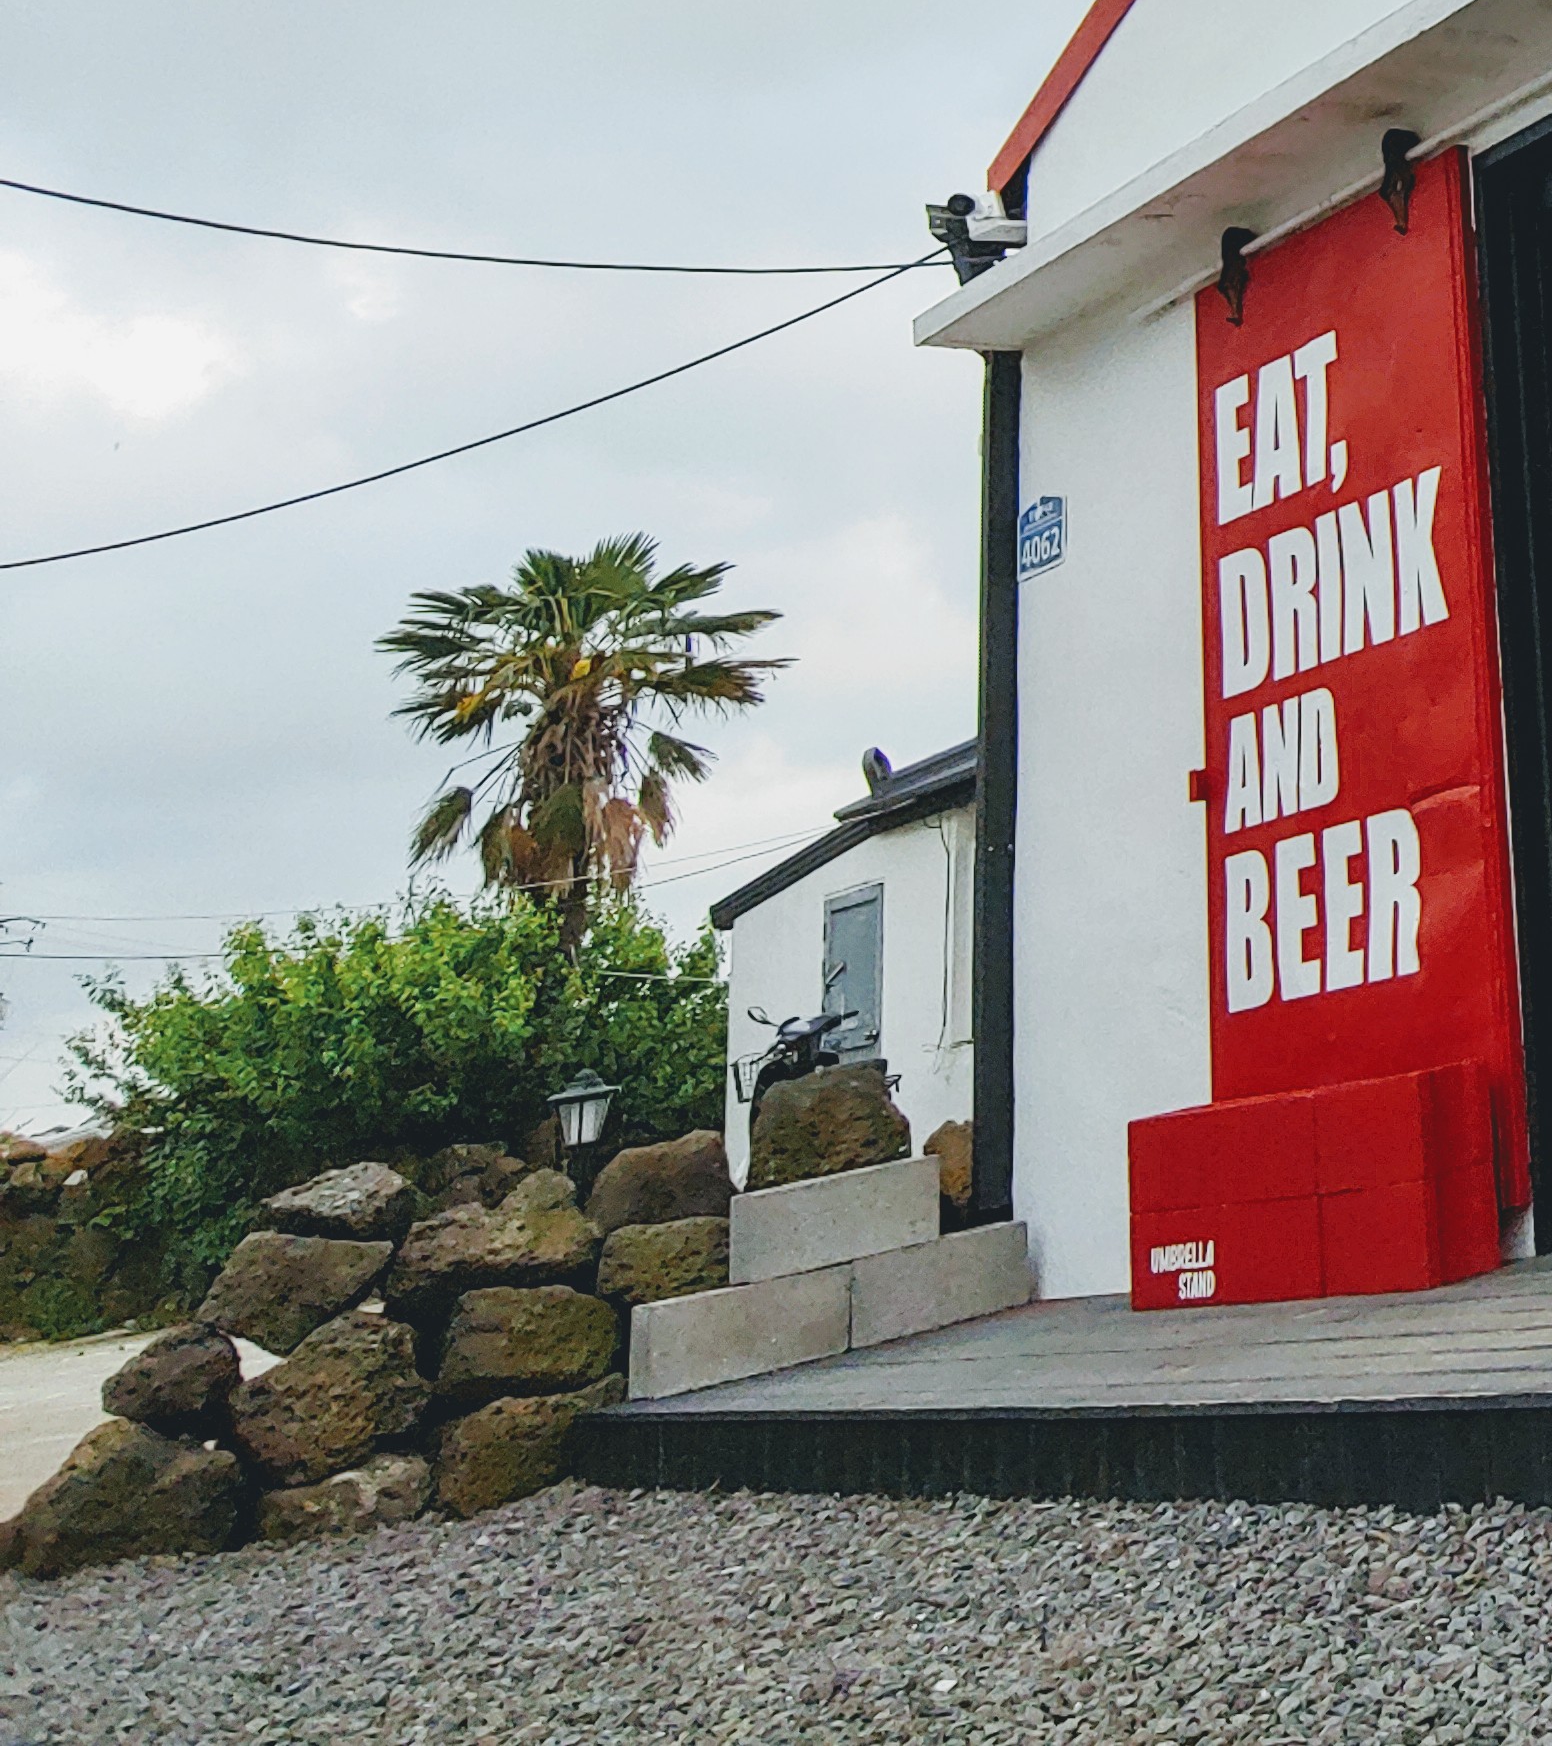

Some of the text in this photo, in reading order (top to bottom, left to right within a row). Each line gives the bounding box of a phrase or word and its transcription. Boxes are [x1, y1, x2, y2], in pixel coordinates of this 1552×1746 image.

[1214, 330, 1348, 526] EAT,
[1021, 525, 1060, 567] 4062
[1219, 465, 1450, 699] DRINK
[1224, 687, 1339, 835] AND
[1224, 808, 1422, 1014] BEER
[1178, 1270, 1216, 1299] STAND
